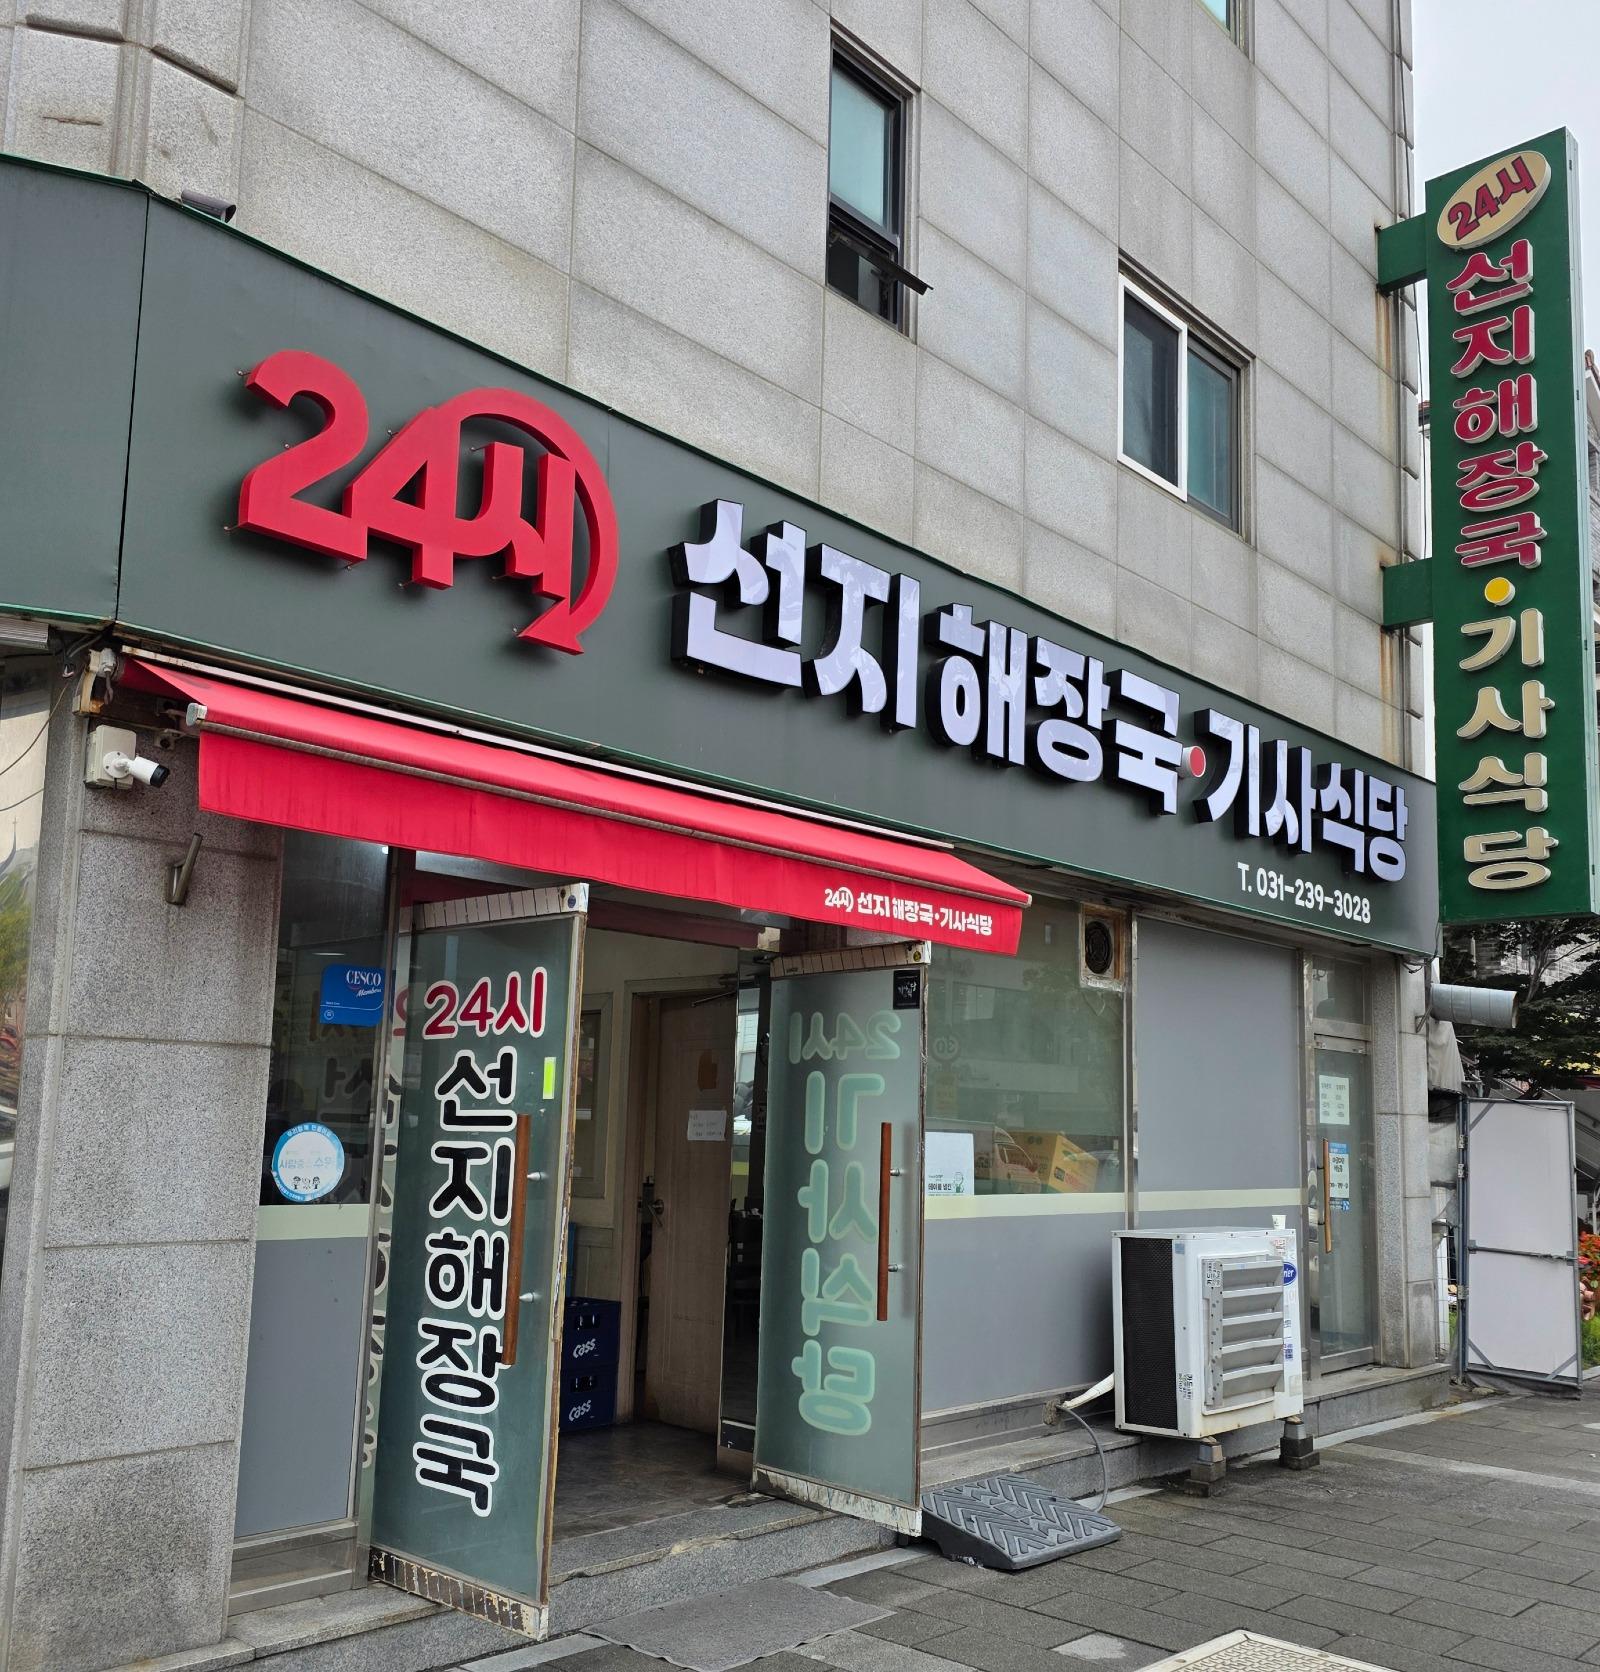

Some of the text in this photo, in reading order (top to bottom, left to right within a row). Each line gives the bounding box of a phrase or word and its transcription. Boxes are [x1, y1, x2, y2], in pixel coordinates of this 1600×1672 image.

[1447, 155, 1536, 241] 24시
[1237, 862, 1371, 924] T. 031-239-3028
[346, 970, 382, 986] CESCO
[423, 966, 548, 1040] 24시
[413, 1045, 518, 1517] 선지해장국
[573, 1338, 596, 1358] Cass
[568, 1400, 592, 1421] Cass
